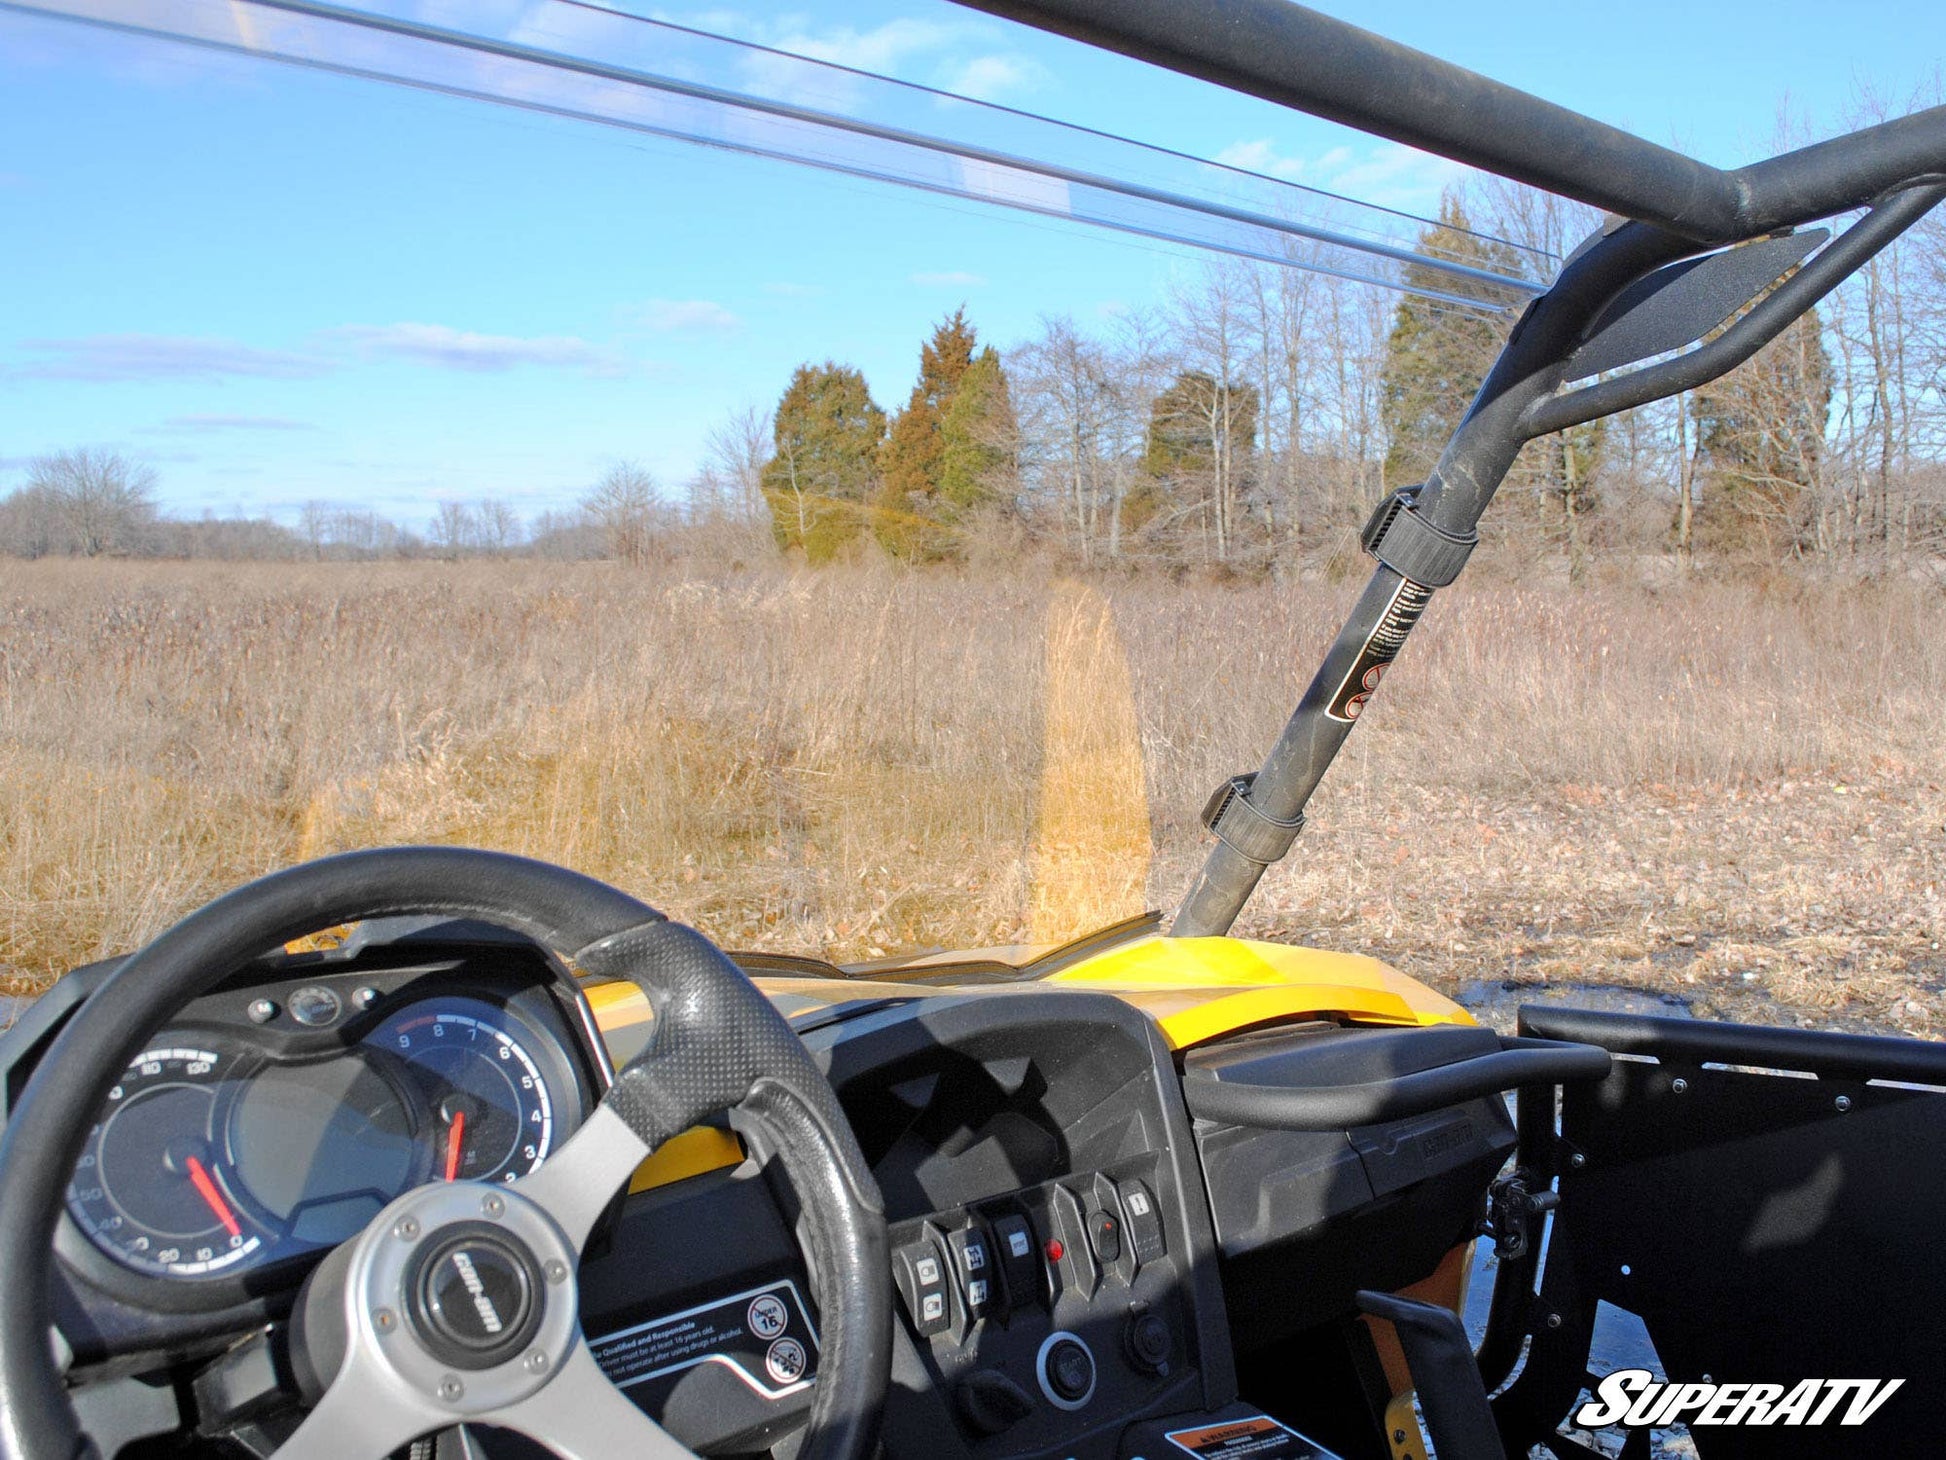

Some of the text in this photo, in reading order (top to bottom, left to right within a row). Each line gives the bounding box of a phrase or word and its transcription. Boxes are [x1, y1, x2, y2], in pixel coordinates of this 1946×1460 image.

[433, 1024, 444, 1037] 8
[467, 1029, 478, 1041] 7
[399, 1035, 410, 1048] 9
[499, 1046, 511, 1060] 6
[142, 1061, 162, 1076] 110
[187, 1062, 211, 1075] 130
[521, 1075, 533, 1089] 5
[531, 1109, 542, 1123] 4
[524, 1145, 536, 1159] 3
[80, 1188, 103, 1201] 50
[98, 1215, 123, 1229] 40
[230, 1235, 243, 1249] 0
[159, 1248, 180, 1264] 20
[196, 1247, 213, 1262] 10
[755, 1306, 778, 1319] UNDER
[761, 1316, 778, 1330] 16
[603, 1339, 637, 1357] Qualified
[637, 1334, 652, 1346] and
[652, 1321, 695, 1340] Responsible
[657, 1339, 674, 1351] least
[684, 1330, 702, 1344] years
[626, 1355, 653, 1373] operate
[654, 1352, 670, 1364] after
[671, 1345, 690, 1358] using
